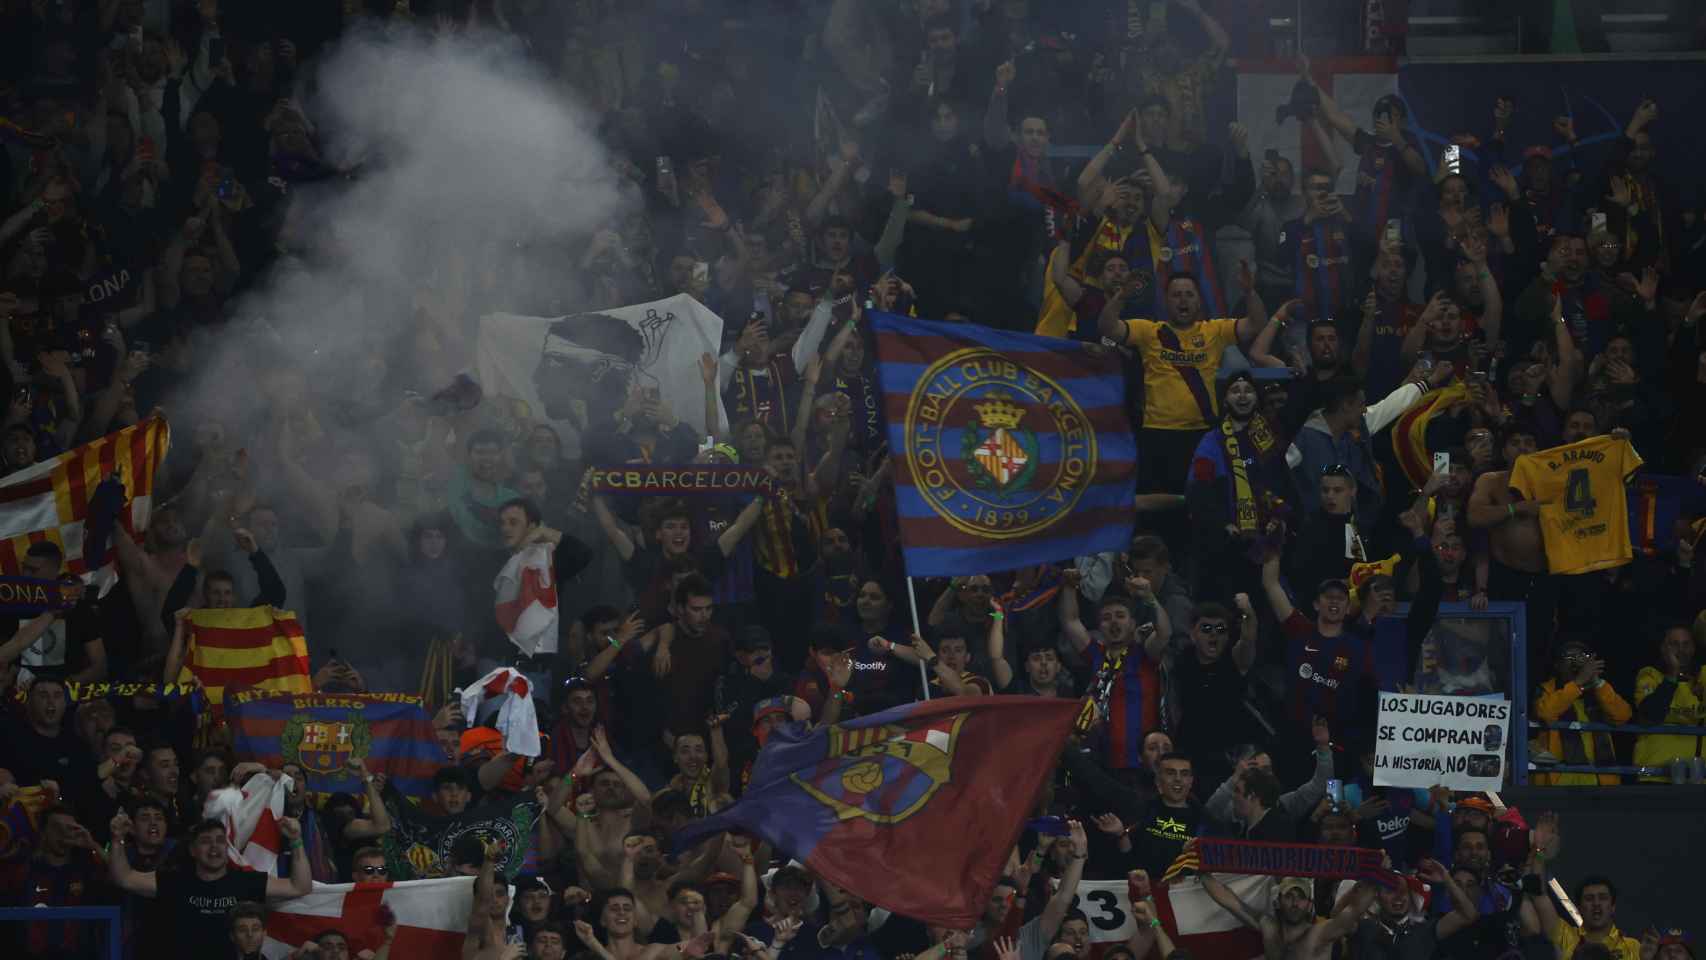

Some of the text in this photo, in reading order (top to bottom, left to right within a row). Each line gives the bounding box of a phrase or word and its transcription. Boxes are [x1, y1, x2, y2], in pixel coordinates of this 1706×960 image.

[1160, 351, 1208, 362] Rakuten
[916, 360, 1085, 503] FOOT-BALL CLUB BARCELONA
[1563, 449, 1606, 464] ARAUJO
[592, 470, 773, 493] FCBARCELONA
[1566, 468, 1597, 518] 4
[975, 505, 1029, 527] 1899
[854, 661, 888, 673] Spotify
[1312, 672, 1341, 690] Spotify
[1381, 698, 1507, 720] LOS JUGADORES
[1378, 726, 1482, 745] SE COMPRAN
[1375, 755, 1388, 768] LA
[1376, 816, 1410, 833] beko
